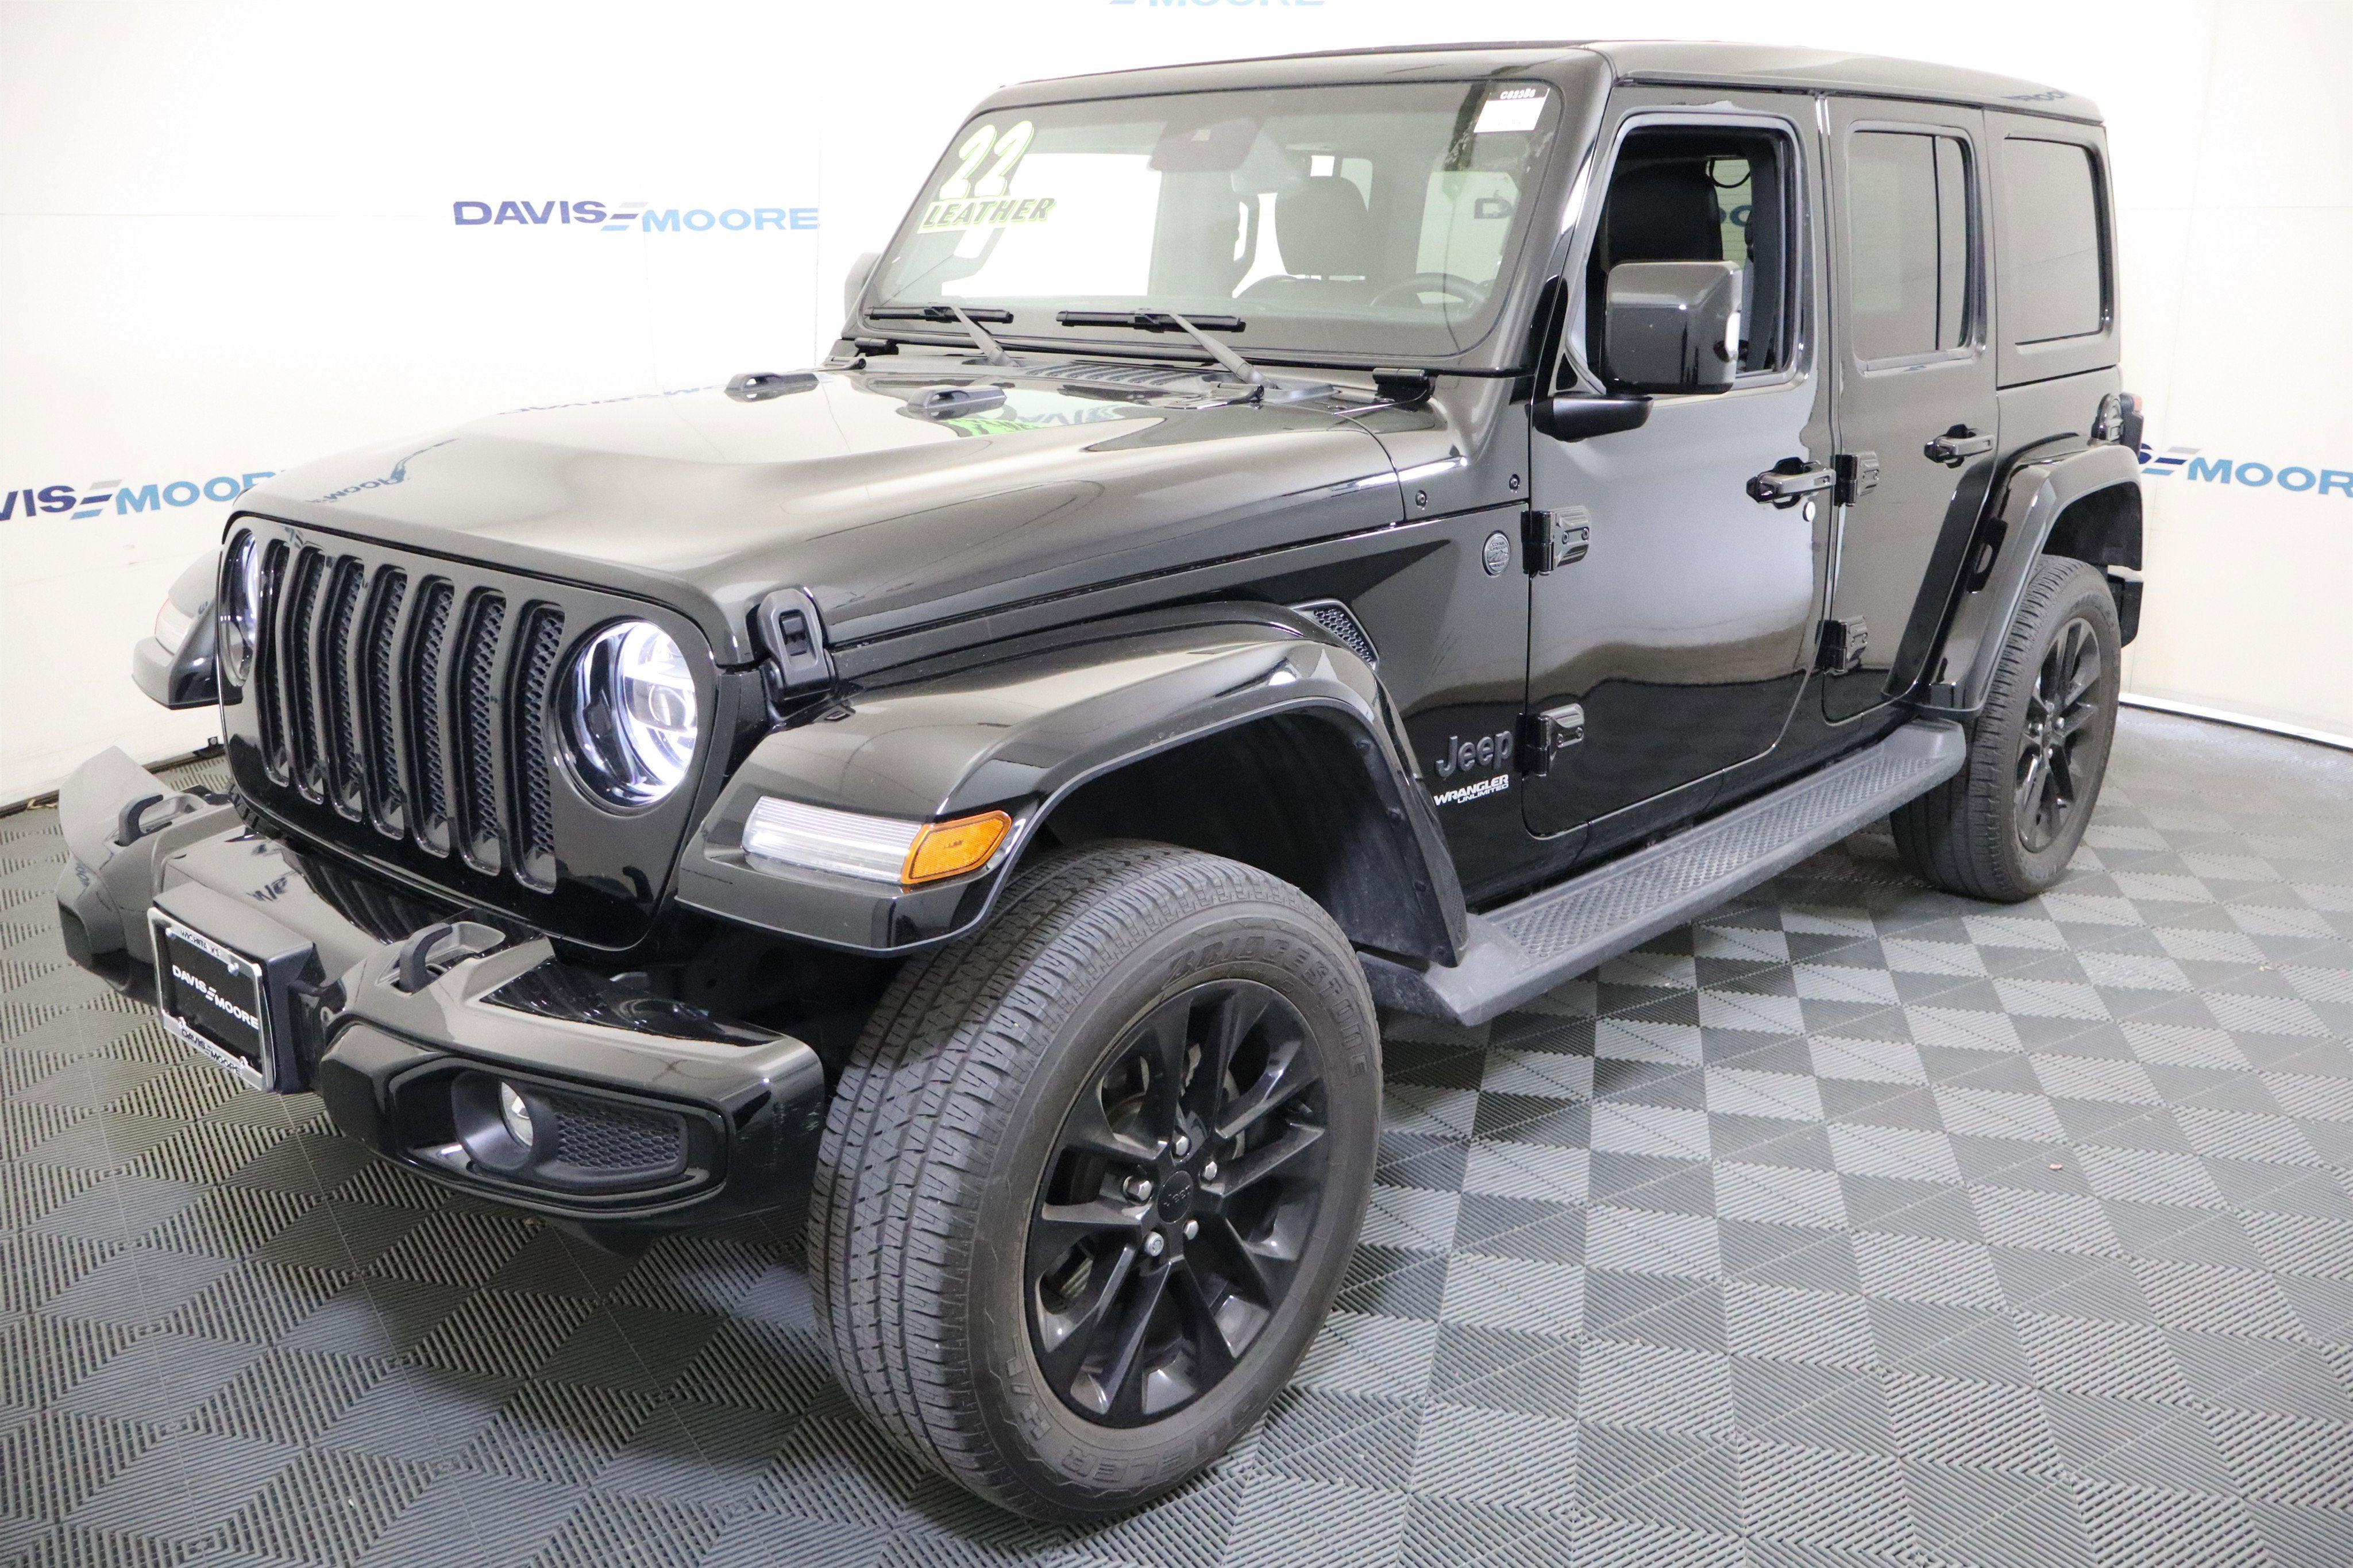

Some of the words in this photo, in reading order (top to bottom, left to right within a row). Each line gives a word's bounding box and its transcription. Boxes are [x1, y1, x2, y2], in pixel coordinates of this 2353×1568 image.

[939, 120, 1035, 200] 22
[453, 200, 608, 225] DAVIS
[641, 207, 819, 232] MOORE
[922, 197, 1056, 229] LEATHER
[1435, 730, 1514, 778] Jeep
[1433, 774, 1509, 806] WRANGLER
[1457, 783, 1509, 804] UNLIMITED
[172, 964, 207, 994] DAVIS
[214, 994, 259, 1030] MOORE
[1161, 936, 1368, 1079] BRIDGESTONE
